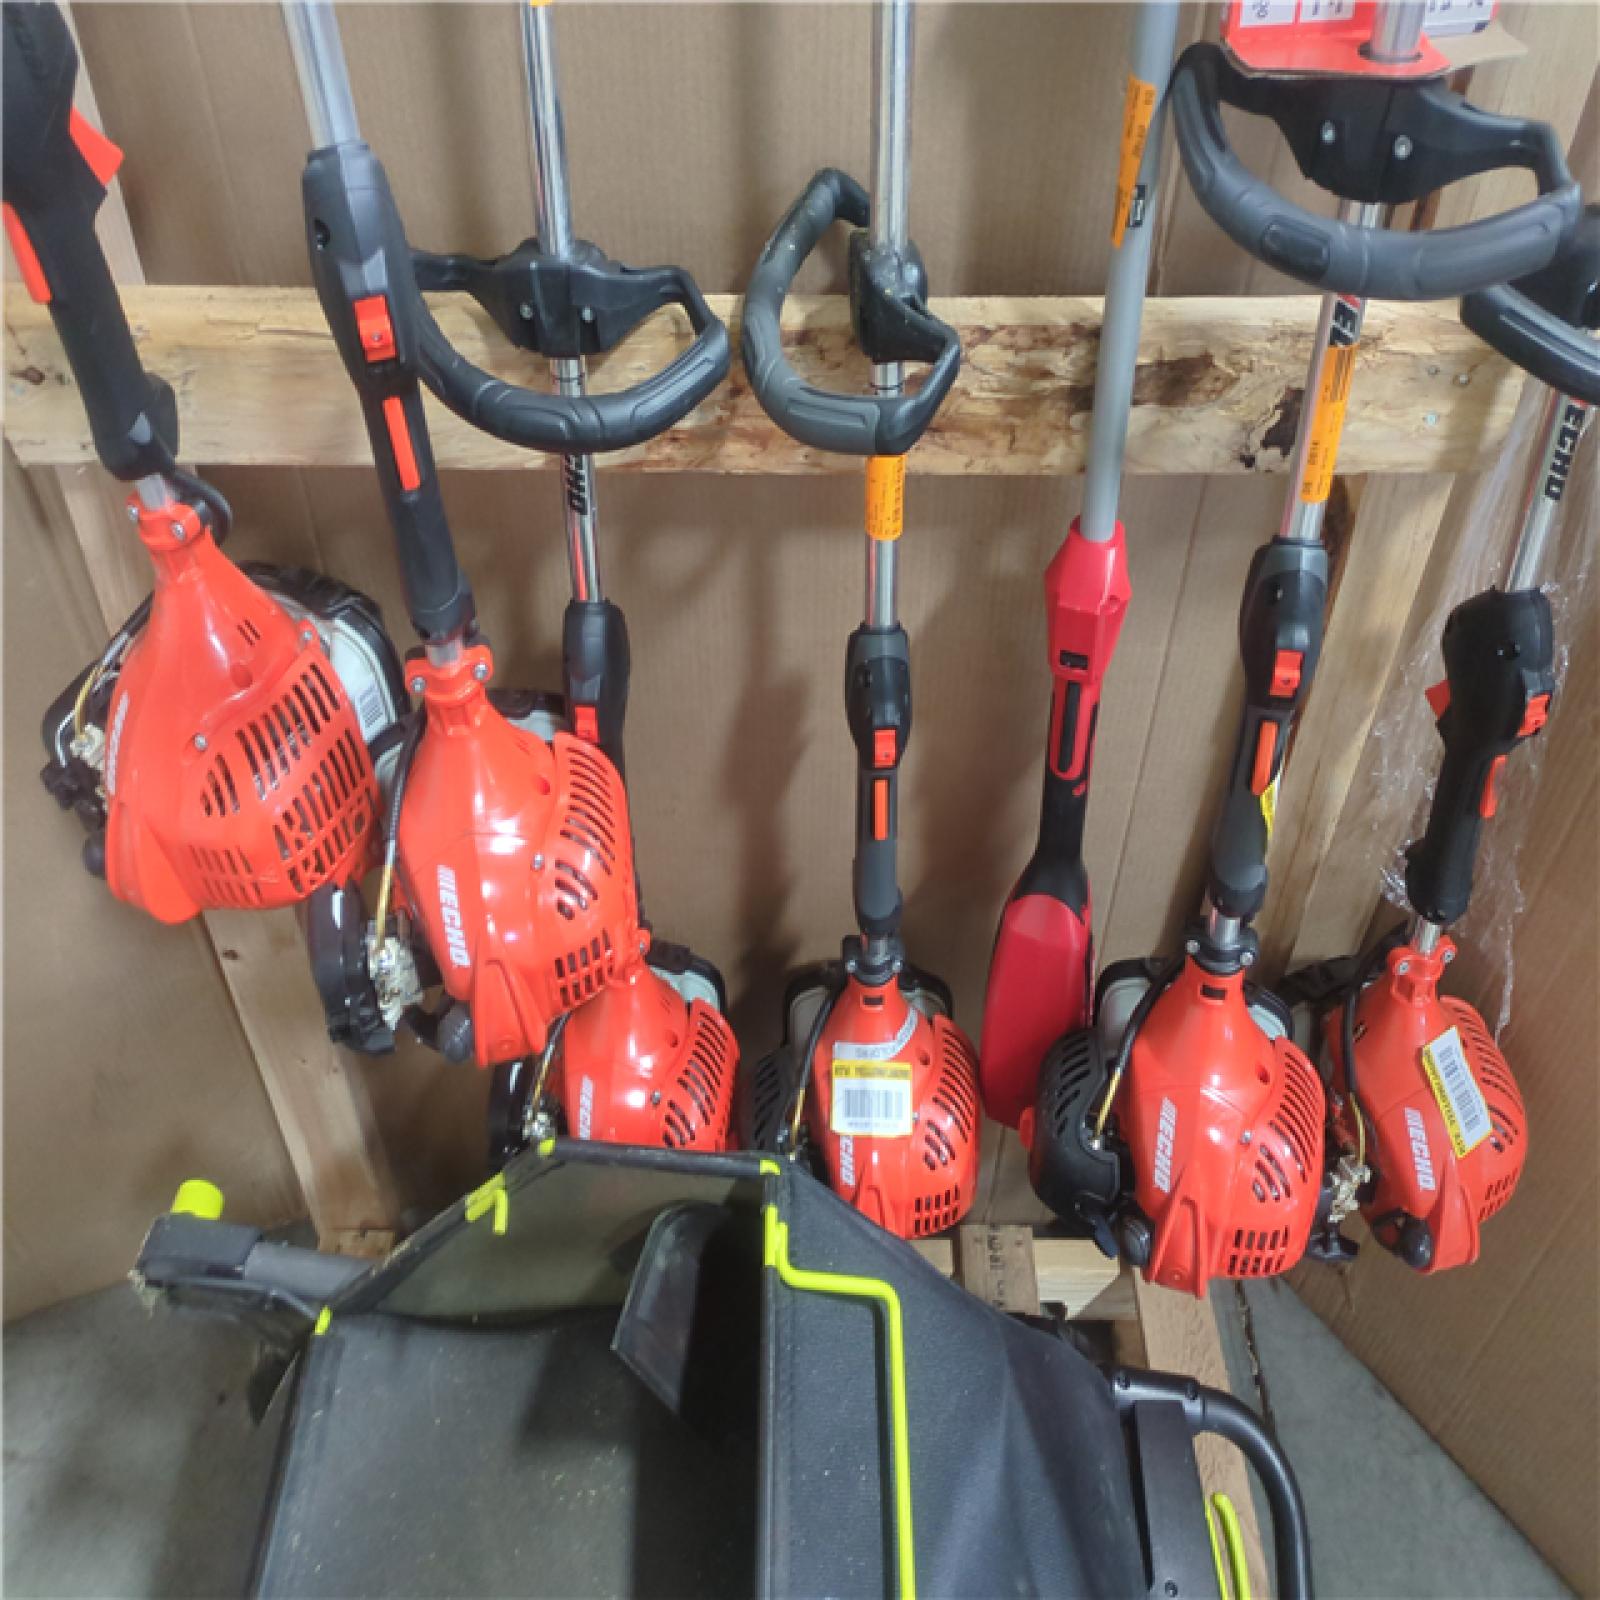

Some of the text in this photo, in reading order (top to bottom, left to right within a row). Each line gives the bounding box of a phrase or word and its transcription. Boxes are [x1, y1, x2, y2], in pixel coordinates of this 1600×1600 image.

[1544, 404, 1586, 501] ECHO
[440, 888, 471, 968] ECHO
[839, 1136, 856, 1186] CHO
[1153, 1116, 1176, 1193] ECHO
[1408, 1126, 1436, 1191] ECHO
